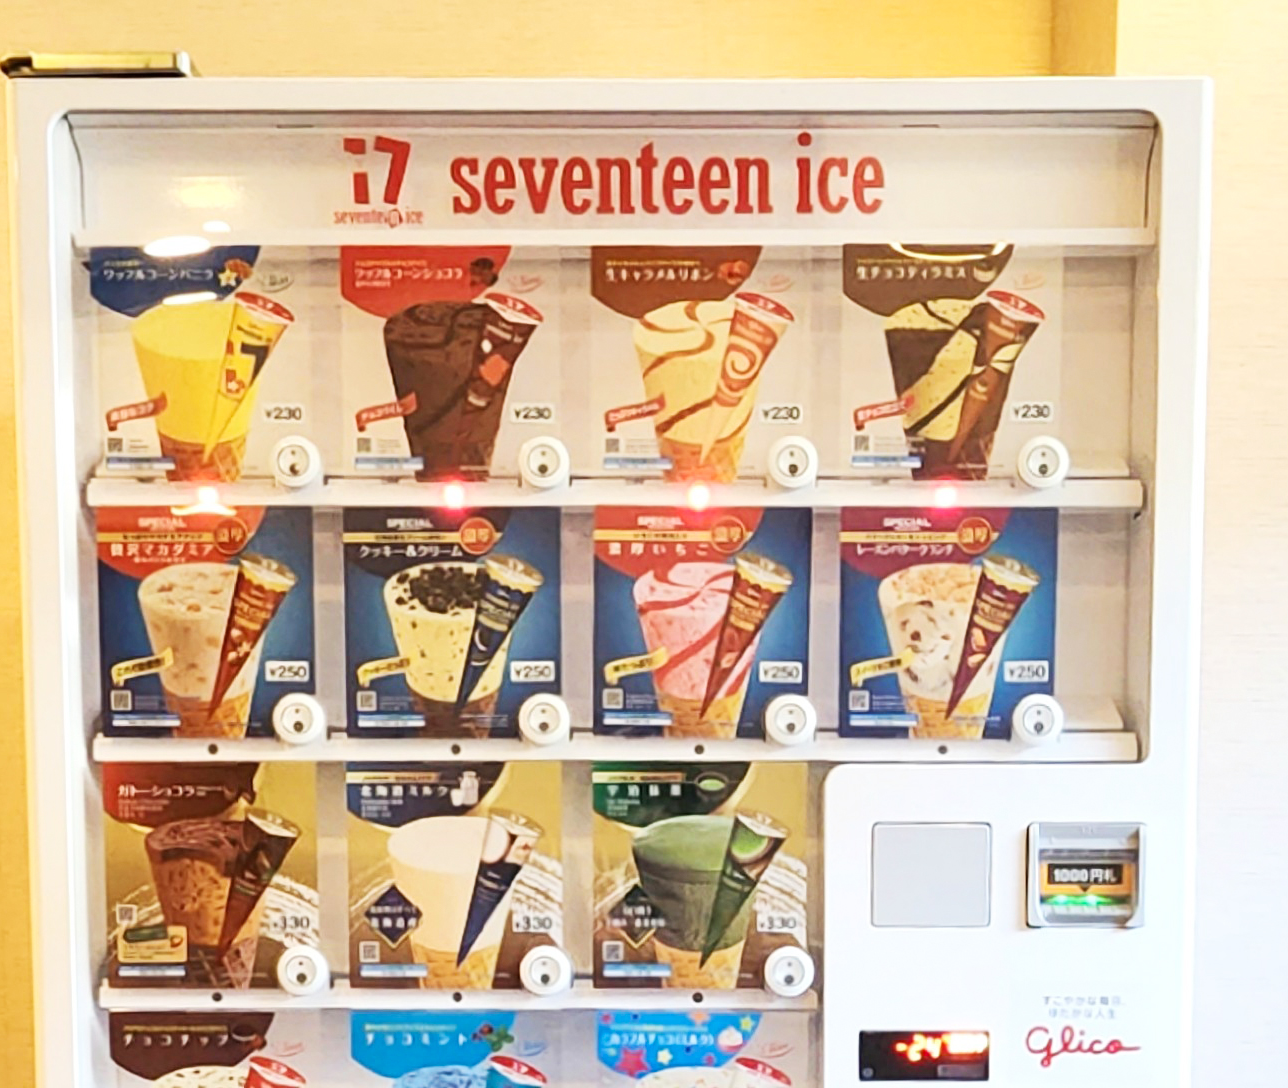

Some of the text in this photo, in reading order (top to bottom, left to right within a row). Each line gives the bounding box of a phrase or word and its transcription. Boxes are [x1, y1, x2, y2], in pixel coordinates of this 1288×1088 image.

[450, 132, 884, 215] seventeen ice
[104, 268, 214, 281] ワッフルコーンバニラ
[514, 407, 552, 420] ¥230
[1014, 404, 1051, 419] ¥230
[111, 543, 213, 557] 贅沢マカダミア
[269, 666, 307, 679] ¥250
[514, 666, 551, 678] ¥250
[764, 666, 800, 679] ¥250
[1009, 665, 1046, 679] ¥250
[1053, 868, 1117, 883] 1000円札
[1025, 1026, 1141, 1068] Glico
